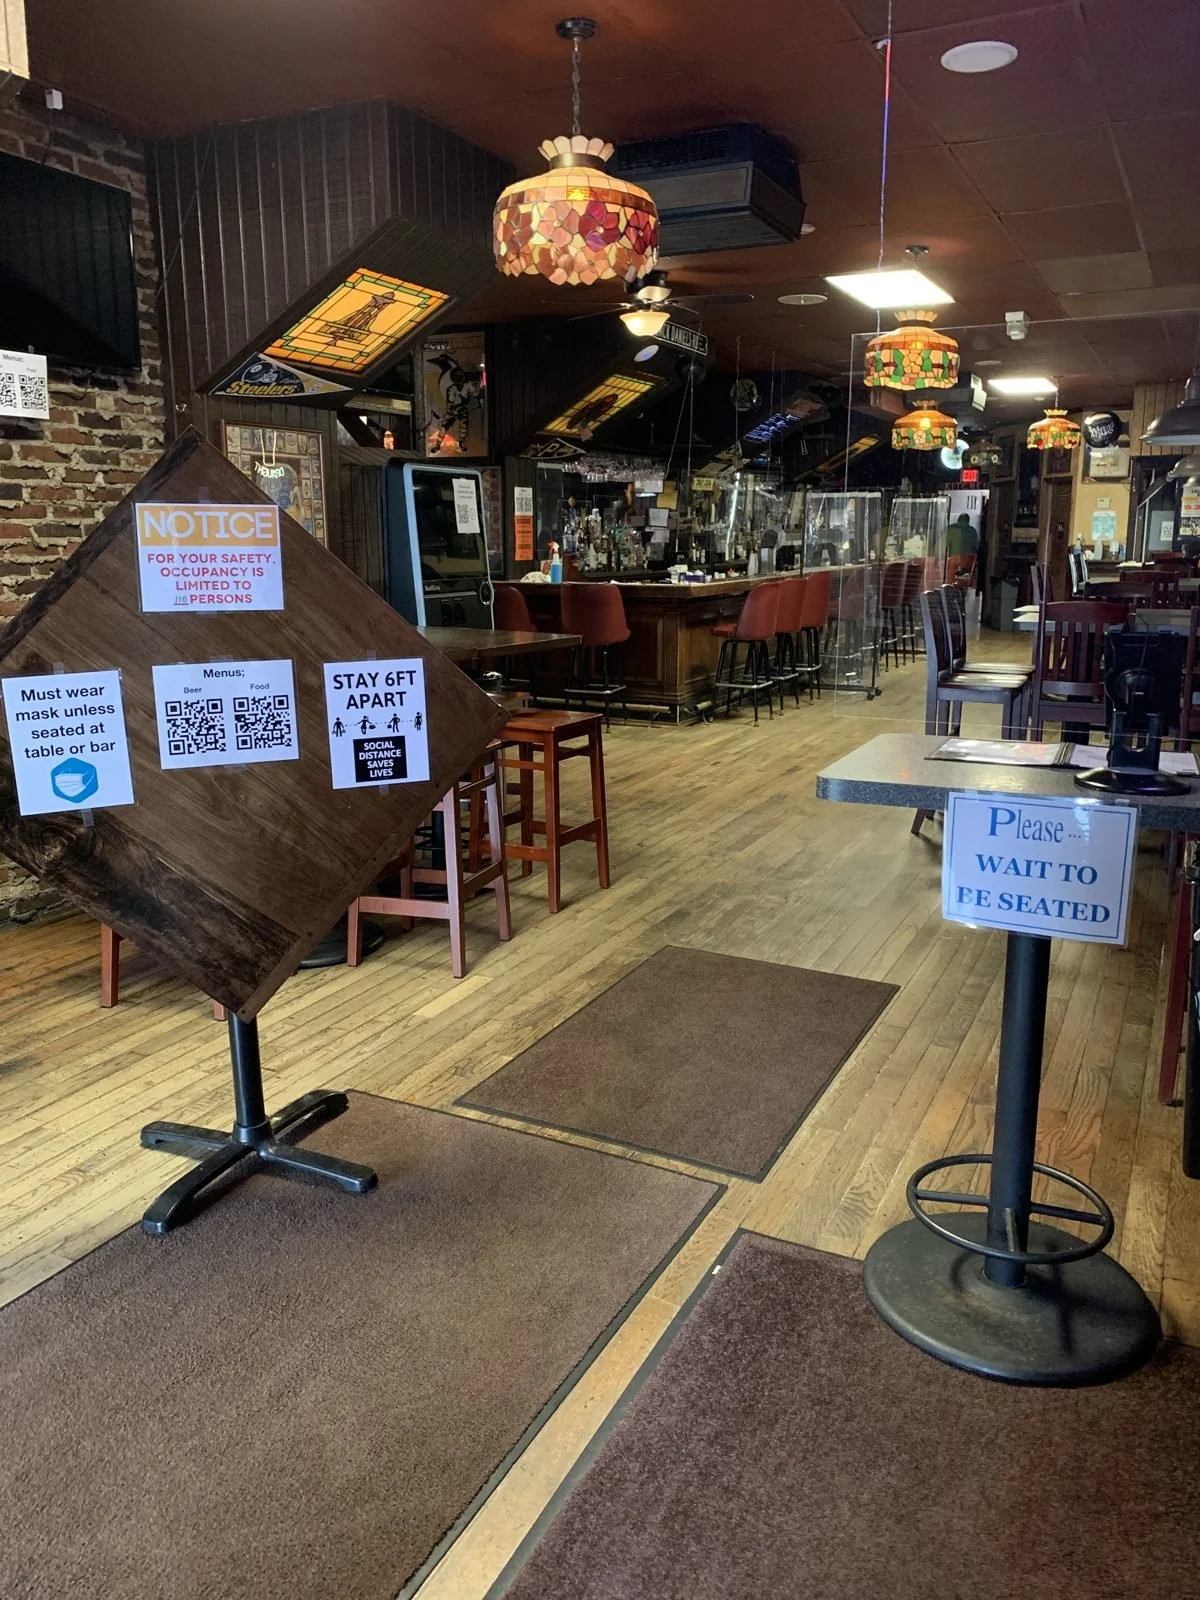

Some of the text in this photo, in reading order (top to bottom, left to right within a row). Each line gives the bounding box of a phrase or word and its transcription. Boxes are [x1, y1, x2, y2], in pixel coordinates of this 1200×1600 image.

[225, 380, 297, 395] Steelers
[963, 470, 977, 482] EXIT
[143, 510, 273, 539] NOTICE
[147, 553, 175, 564] FOR
[179, 553, 218, 564] YOUR
[160, 567, 264, 578] OCCUPANCY IS
[175, 581, 252, 591] LIMITED TO
[190, 594, 253, 604] PERSONS
[203, 669, 245, 679] Menus;
[333, 670, 417, 690] STAY 6FT
[20, 686, 105, 702] Must wear
[346, 691, 407, 710] APART
[15, 704, 116, 722] mask unless
[31, 722, 105, 740] seated at
[24, 741, 116, 759] table or bar
[363, 741, 395, 750] SOCIAL
[358, 749, 402, 760] DISTANCE
[367, 759, 394, 769] SAVES
[369, 768, 393, 778] LIVES
[975, 853, 1098, 885] WAIT TO
[956, 886, 1110, 923] BE SEATED
